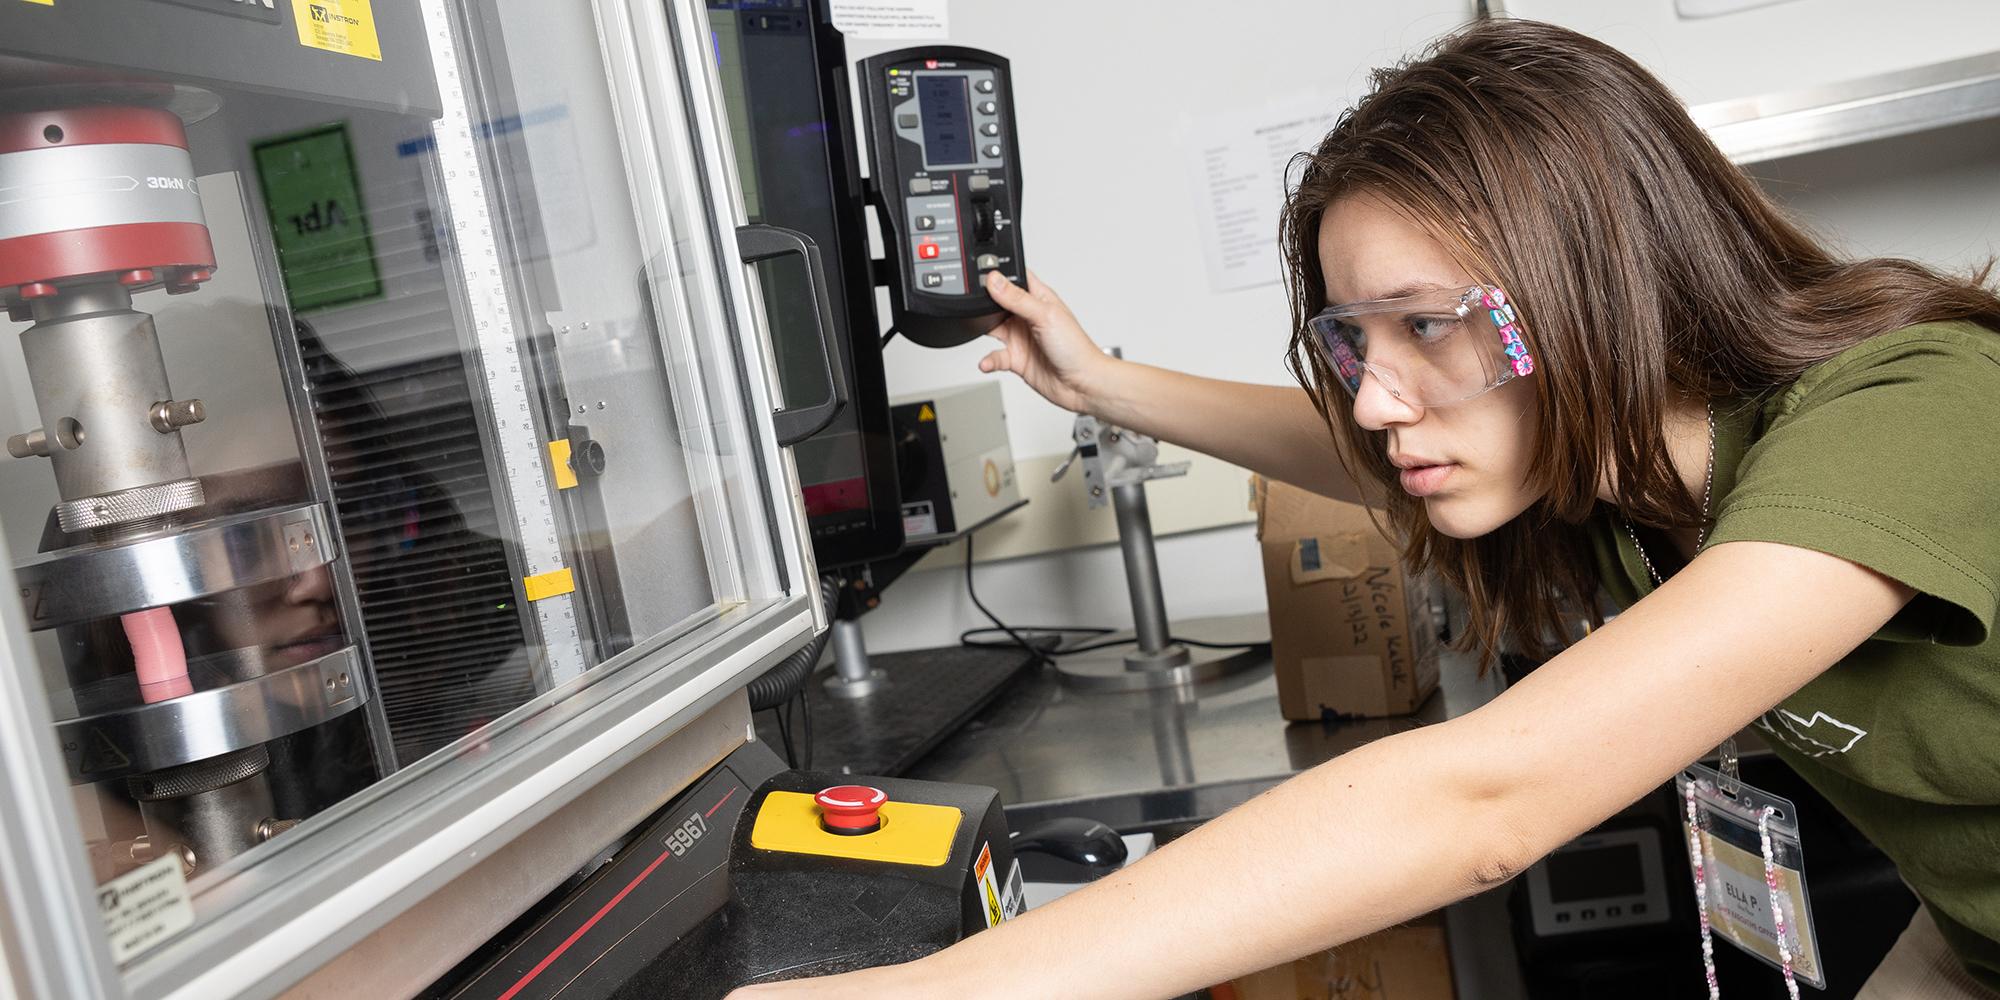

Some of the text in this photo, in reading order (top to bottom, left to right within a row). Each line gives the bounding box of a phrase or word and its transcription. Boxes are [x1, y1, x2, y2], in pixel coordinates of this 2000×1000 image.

[328, 12, 360, 27] INSTRON
[146, 176, 185, 191] 30kN
[1365, 566, 1397, 630] Nicole
[665, 812, 706, 856] 5967
[1726, 882, 1748, 904] ELLA
[1750, 895, 1761, 911] P.
